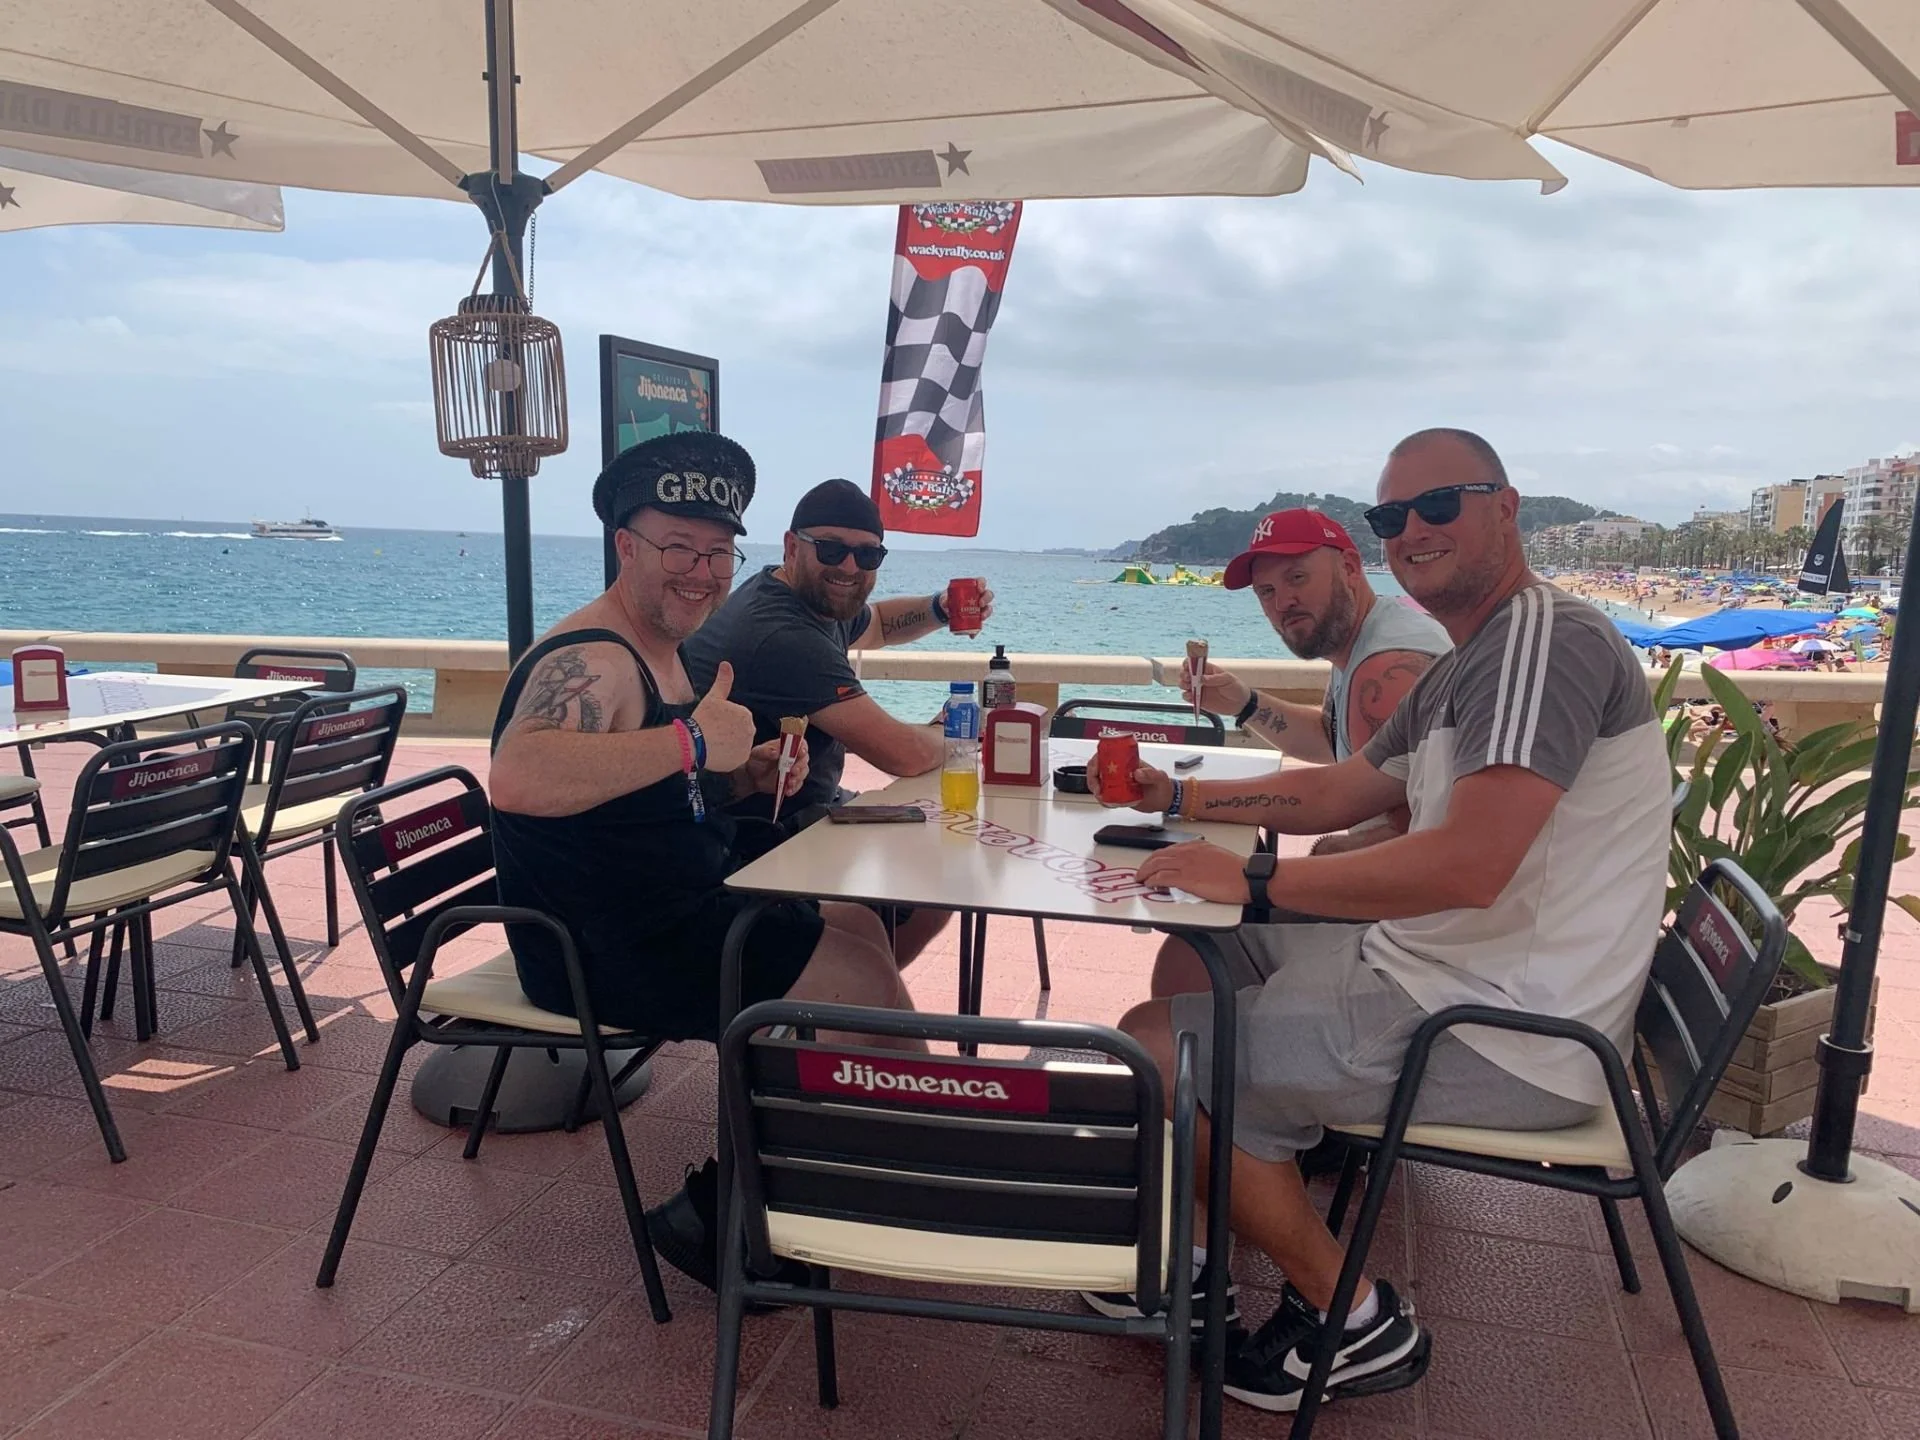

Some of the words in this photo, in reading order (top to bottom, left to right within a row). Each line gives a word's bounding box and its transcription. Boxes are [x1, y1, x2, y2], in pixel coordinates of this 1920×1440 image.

[926, 203, 961, 215] Wacky
[963, 204, 995, 220] Rally
[907, 244, 1006, 261] wackyrally.co.uk
[637, 375, 689, 403] Jijonenca
[927, 483, 956, 497] Rally
[318, 717, 365, 736] Jijonenca
[128, 762, 199, 788] Jijonenca
[395, 815, 453, 851] Jijonenca
[832, 1060, 1010, 1101] Jijonenca
